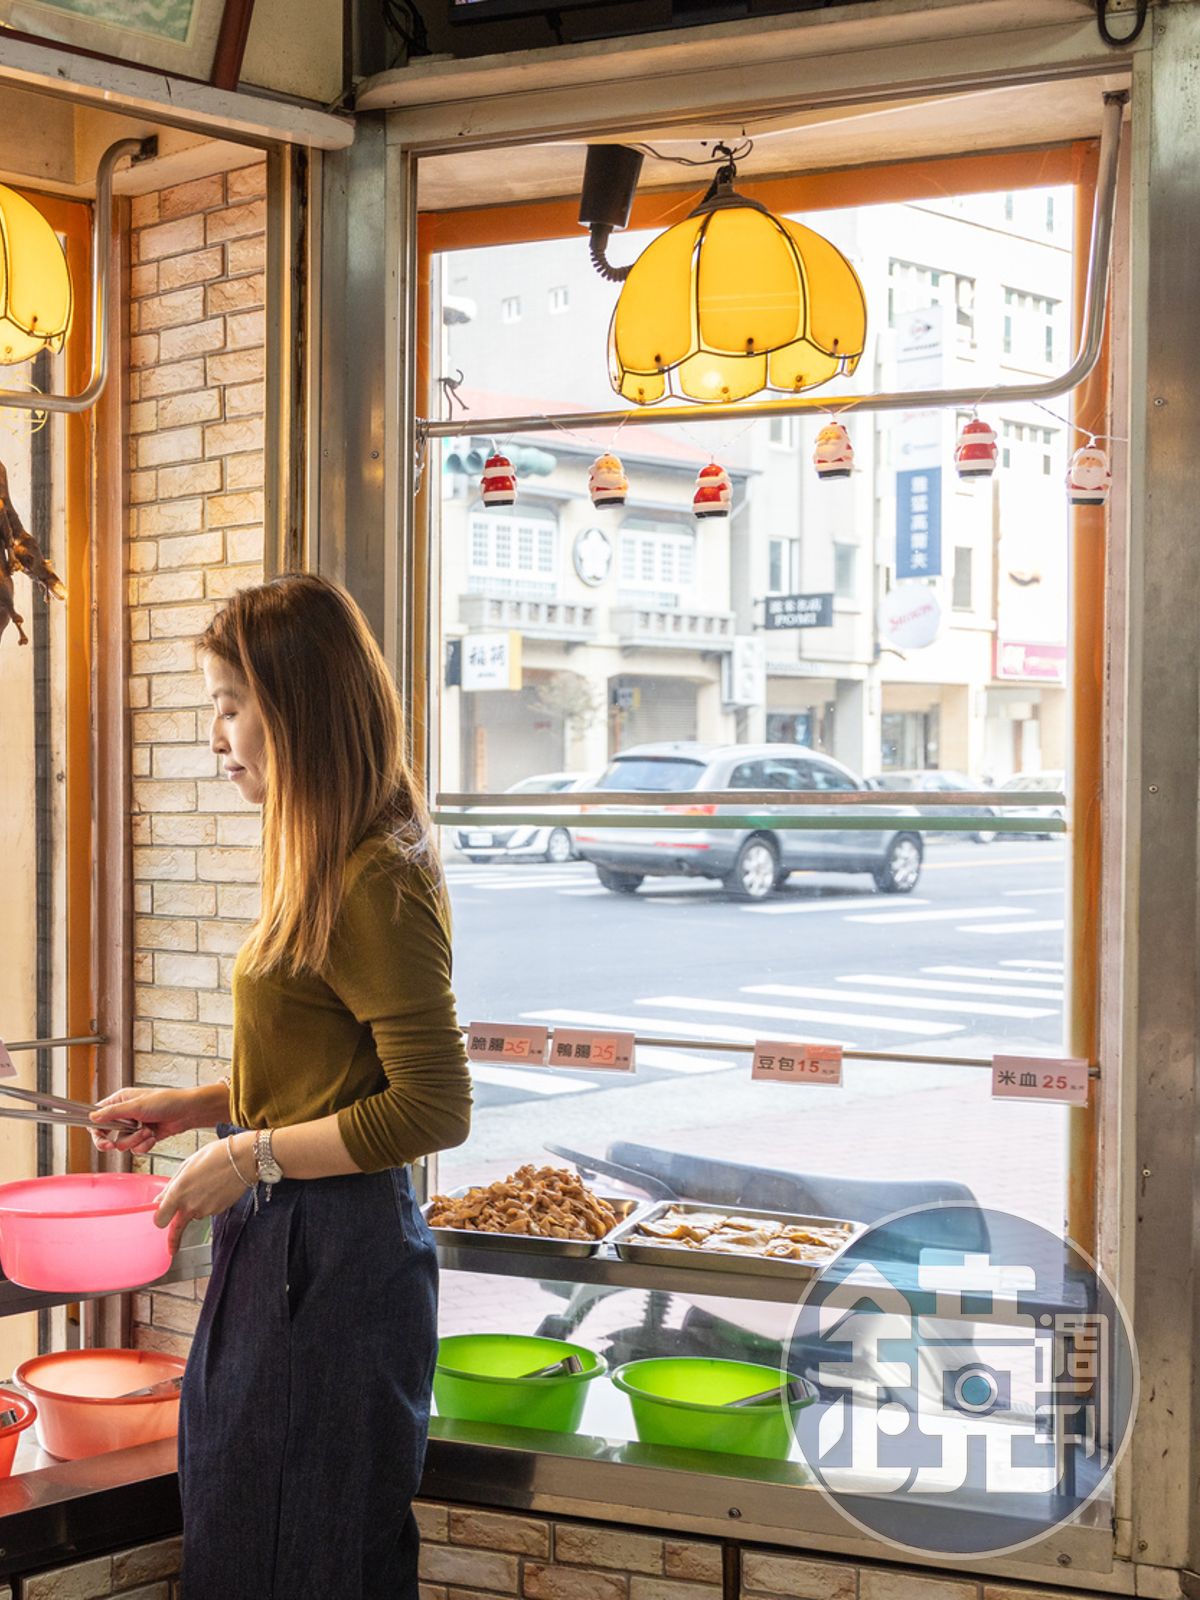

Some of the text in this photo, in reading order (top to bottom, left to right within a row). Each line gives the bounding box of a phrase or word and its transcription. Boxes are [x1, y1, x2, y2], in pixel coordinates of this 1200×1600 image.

[504, 1039, 529, 1055] 25
[591, 1045, 615, 1059] 25
[757, 1055, 795, 1072] 豆包
[797, 1059, 820, 1073] 15
[997, 1070, 1038, 1087] 米血
[1042, 1074, 1068, 1089] 25
